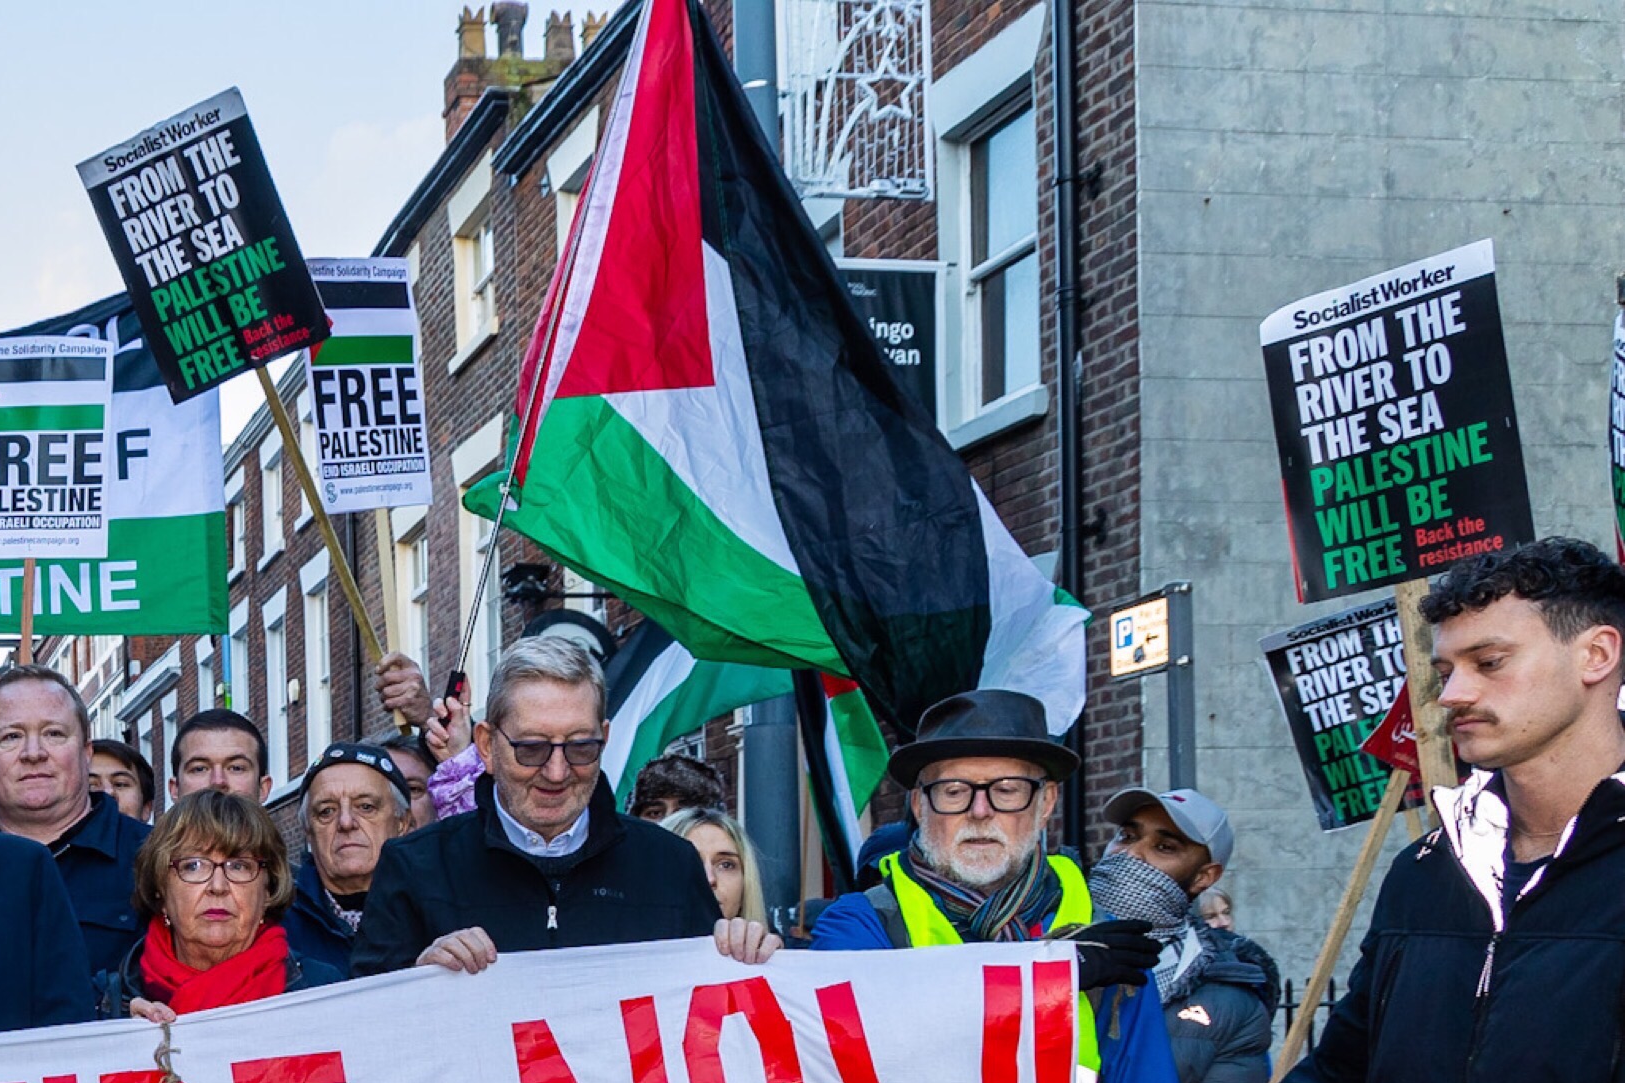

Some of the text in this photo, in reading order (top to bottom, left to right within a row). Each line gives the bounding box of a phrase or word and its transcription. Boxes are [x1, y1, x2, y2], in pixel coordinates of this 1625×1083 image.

[107, 129, 242, 219] FROM THE
[121, 173, 241, 255] RIVER TO
[135, 213, 246, 288] THE SEA
[336, 264, 371, 279] Solidarity
[372, 265, 407, 280] Campaign
[150, 236, 286, 323] PALESTINE
[162, 285, 269, 356] WILL BE
[242, 313, 296, 345] Back the
[1288, 290, 1467, 383] FROM THE
[12, 343, 57, 356] Solidarity
[58, 343, 107, 356] Campaign
[178, 335, 245, 390] FREE
[312, 367, 422, 430] FREE
[1295, 342, 1452, 425] RIVER TO
[319, 427, 424, 460] PALESTINE
[1300, 391, 1445, 465] THE SEA
[323, 458, 425, 479] END ISRAELI OCCUPATION
[1309, 421, 1494, 507] PALESTINE
[32, 516, 100, 529] OCCUPATION
[1315, 477, 1453, 548] WILL BE
[1415, 516, 1486, 548] Back the
[1323, 534, 1407, 590] FREE
[1418, 534, 1505, 568] resistance
[1286, 617, 1403, 675] FROM TH
[1295, 654, 1374, 704] RIVER
[1303, 691, 1357, 732] THE
[1321, 753, 1387, 791] WILL
